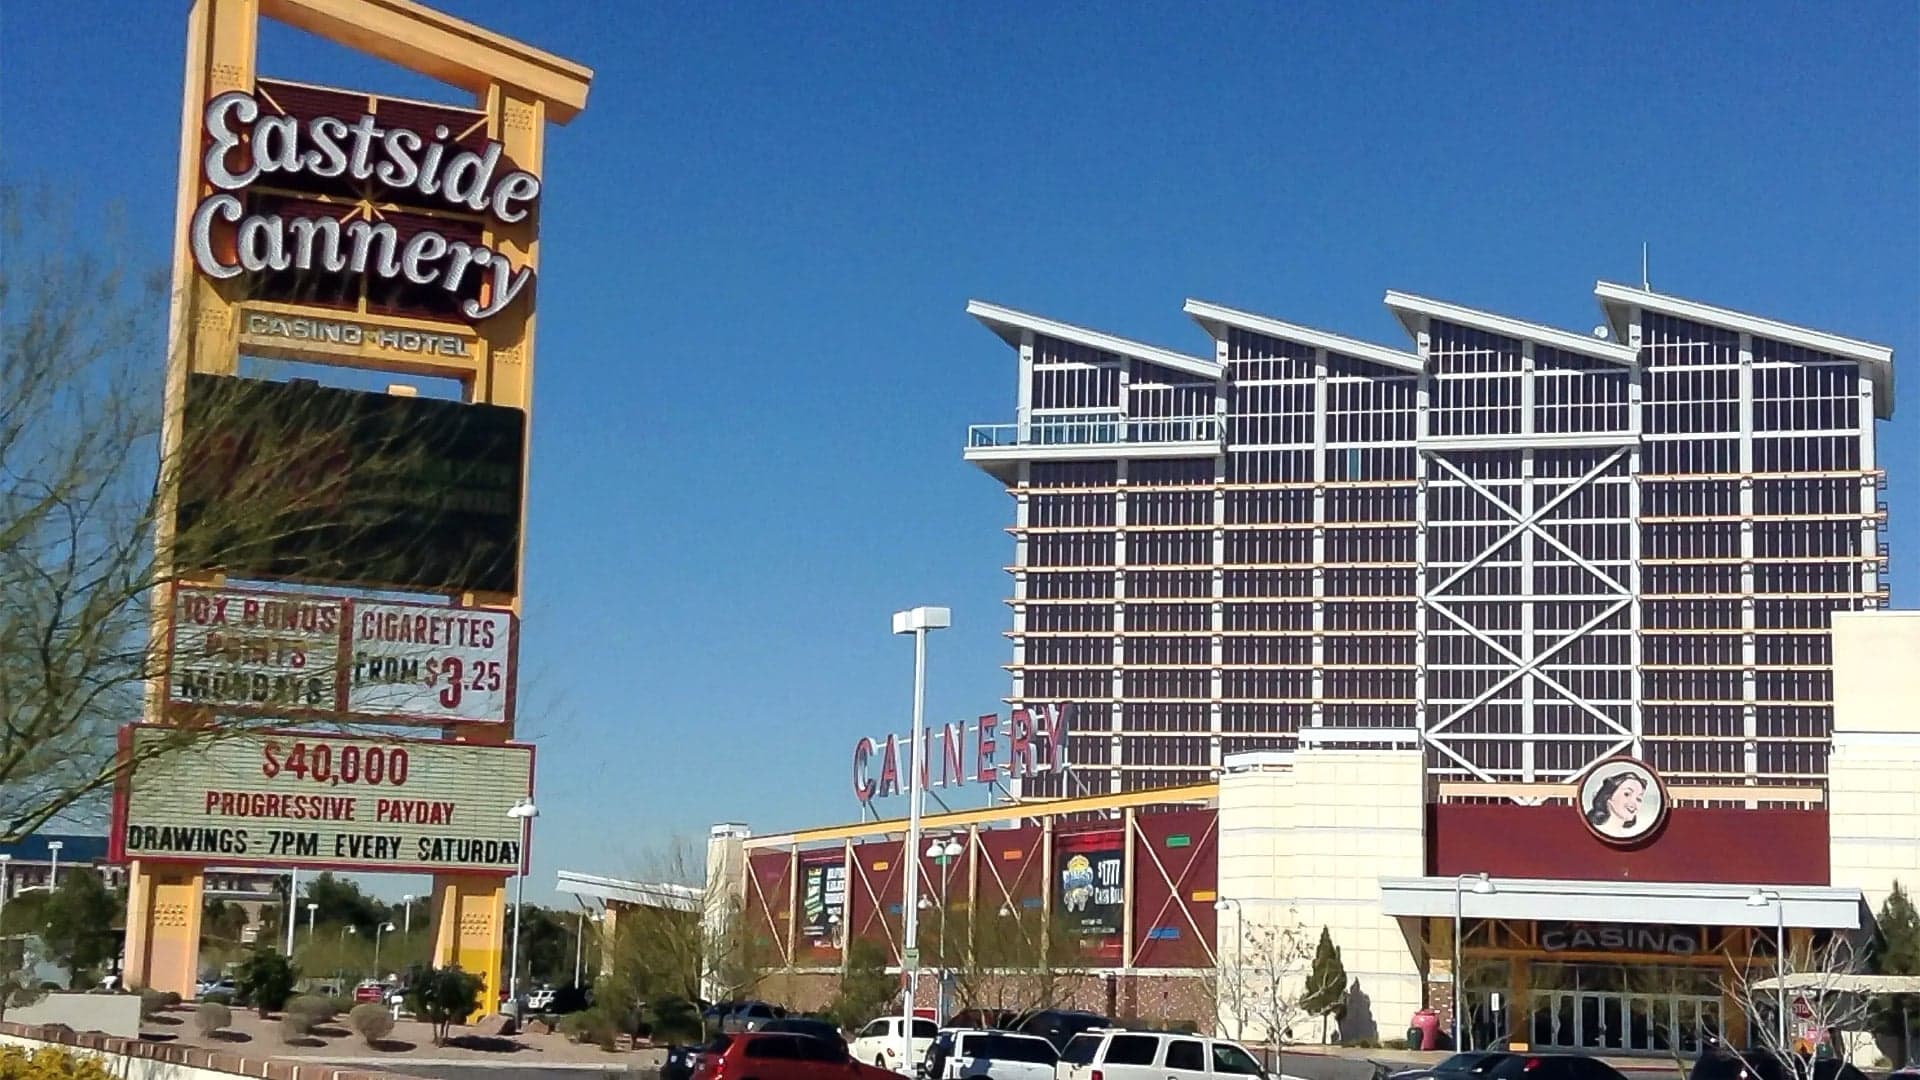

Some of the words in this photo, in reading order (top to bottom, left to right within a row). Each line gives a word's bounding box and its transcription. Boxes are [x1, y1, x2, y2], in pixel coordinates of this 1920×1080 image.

[205, 91, 541, 223] Eastside
[191, 193, 533, 320] Cannery
[249, 314, 362, 345] CASINO
[377, 328, 474, 359] HOTEL
[362, 611, 495, 649] CIGARETTES
[355, 652, 418, 688] FROM
[425, 656, 501, 709] $3.25
[262, 741, 409, 787] $40,000
[206, 791, 356, 821] PROGRESSIVE
[376, 799, 455, 825] PAYDAY
[127, 825, 248, 854] DRAWINGS
[268, 830, 319, 856] 7PM
[335, 834, 402, 860] EVERY
[418, 837, 521, 864] SATURDAY
[1542, 928, 1697, 955] CASINO
